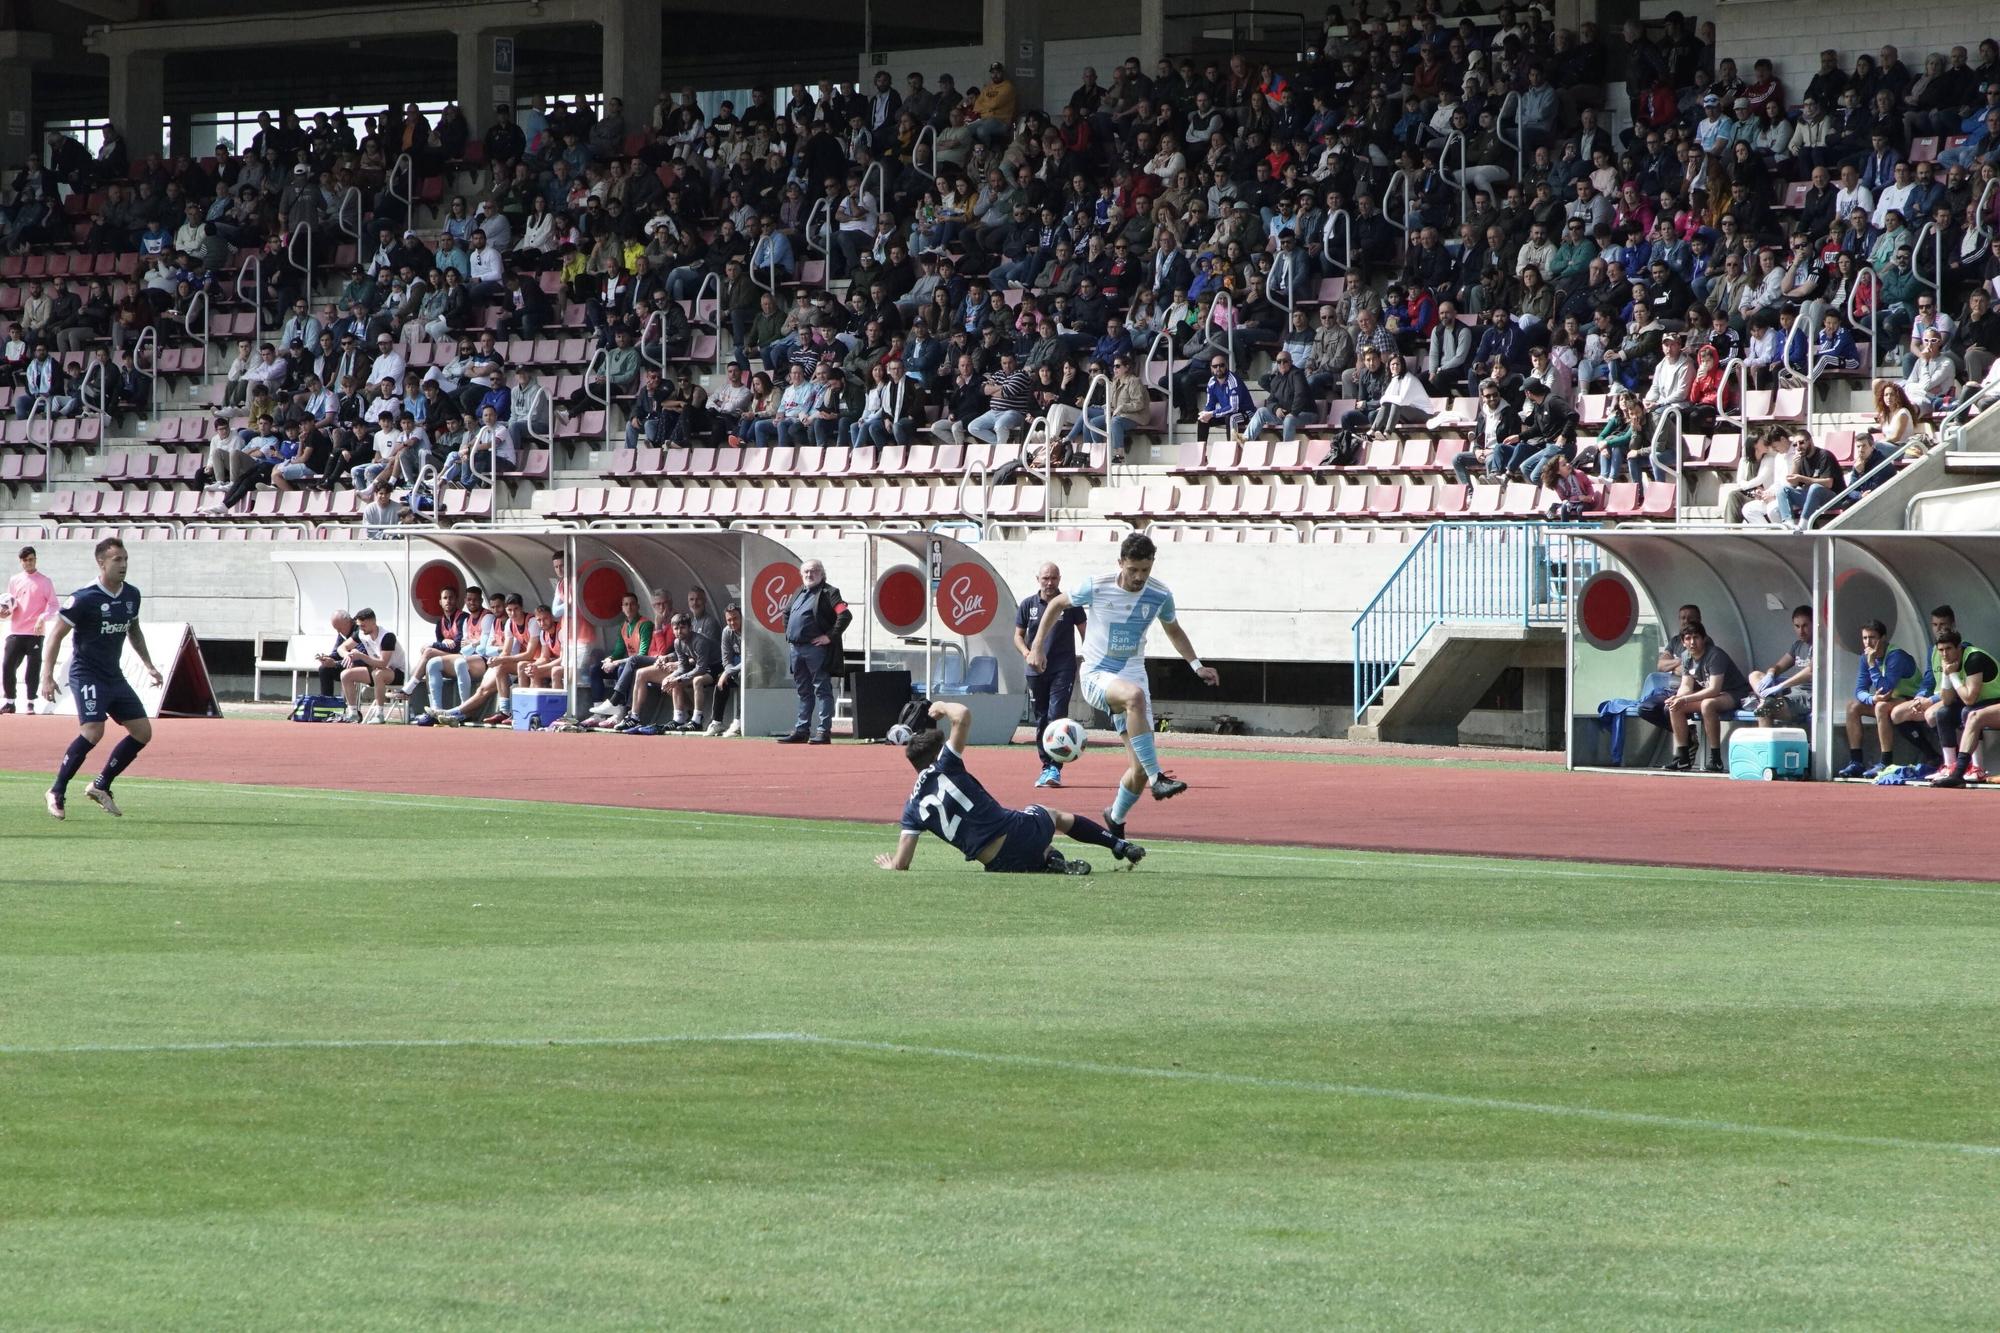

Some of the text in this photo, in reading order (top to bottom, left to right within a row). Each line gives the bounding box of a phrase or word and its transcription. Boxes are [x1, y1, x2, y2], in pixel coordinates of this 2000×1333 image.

[765, 575, 792, 617] Sa
[950, 576, 984, 620] San
[1112, 635, 1130, 644] San
[80, 684, 97, 700] 11
[919, 773, 975, 842] 21
